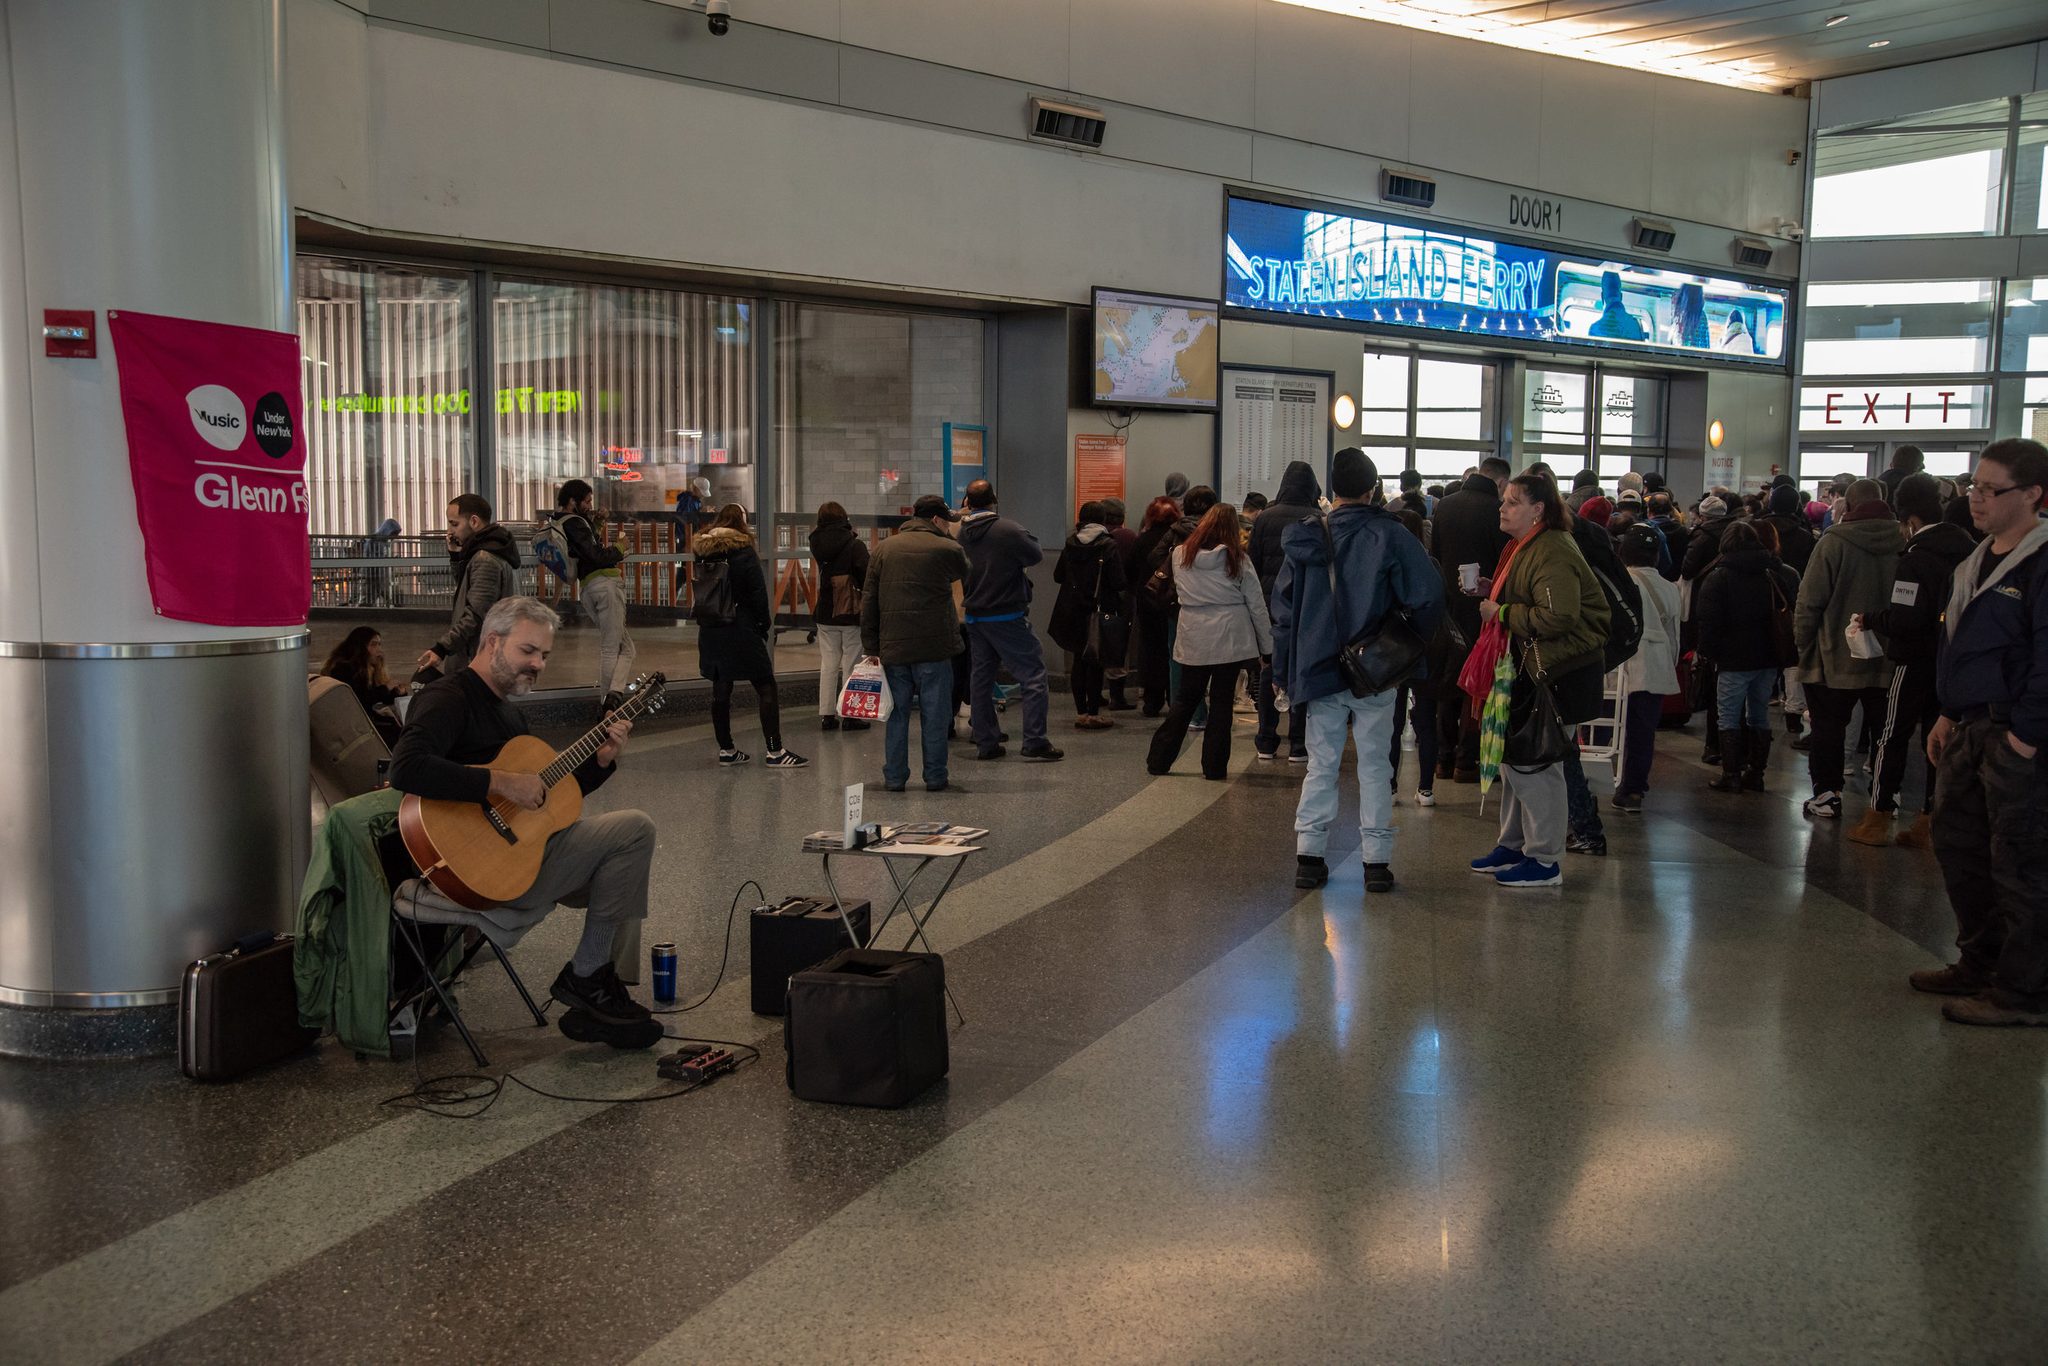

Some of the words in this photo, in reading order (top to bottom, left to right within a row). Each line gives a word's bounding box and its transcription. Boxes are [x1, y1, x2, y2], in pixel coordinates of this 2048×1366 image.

[1510, 194, 1551, 231] DOOR
[1556, 203, 1562, 232] 1
[1247, 255, 1338, 304] STATEN
[1343, 245, 1447, 301] ISLAND
[1460, 252, 1546, 310] FERRY
[194, 408, 240, 428] Music
[264, 411, 285, 424] Under
[1826, 392, 1956, 424] EXIT
[256, 424, 278, 436] New
[278, 427, 291, 438] York
[711, 450, 726, 462] EXIT
[1711, 457, 1734, 468] NOTICE
[194, 472, 287, 513] Glenn
